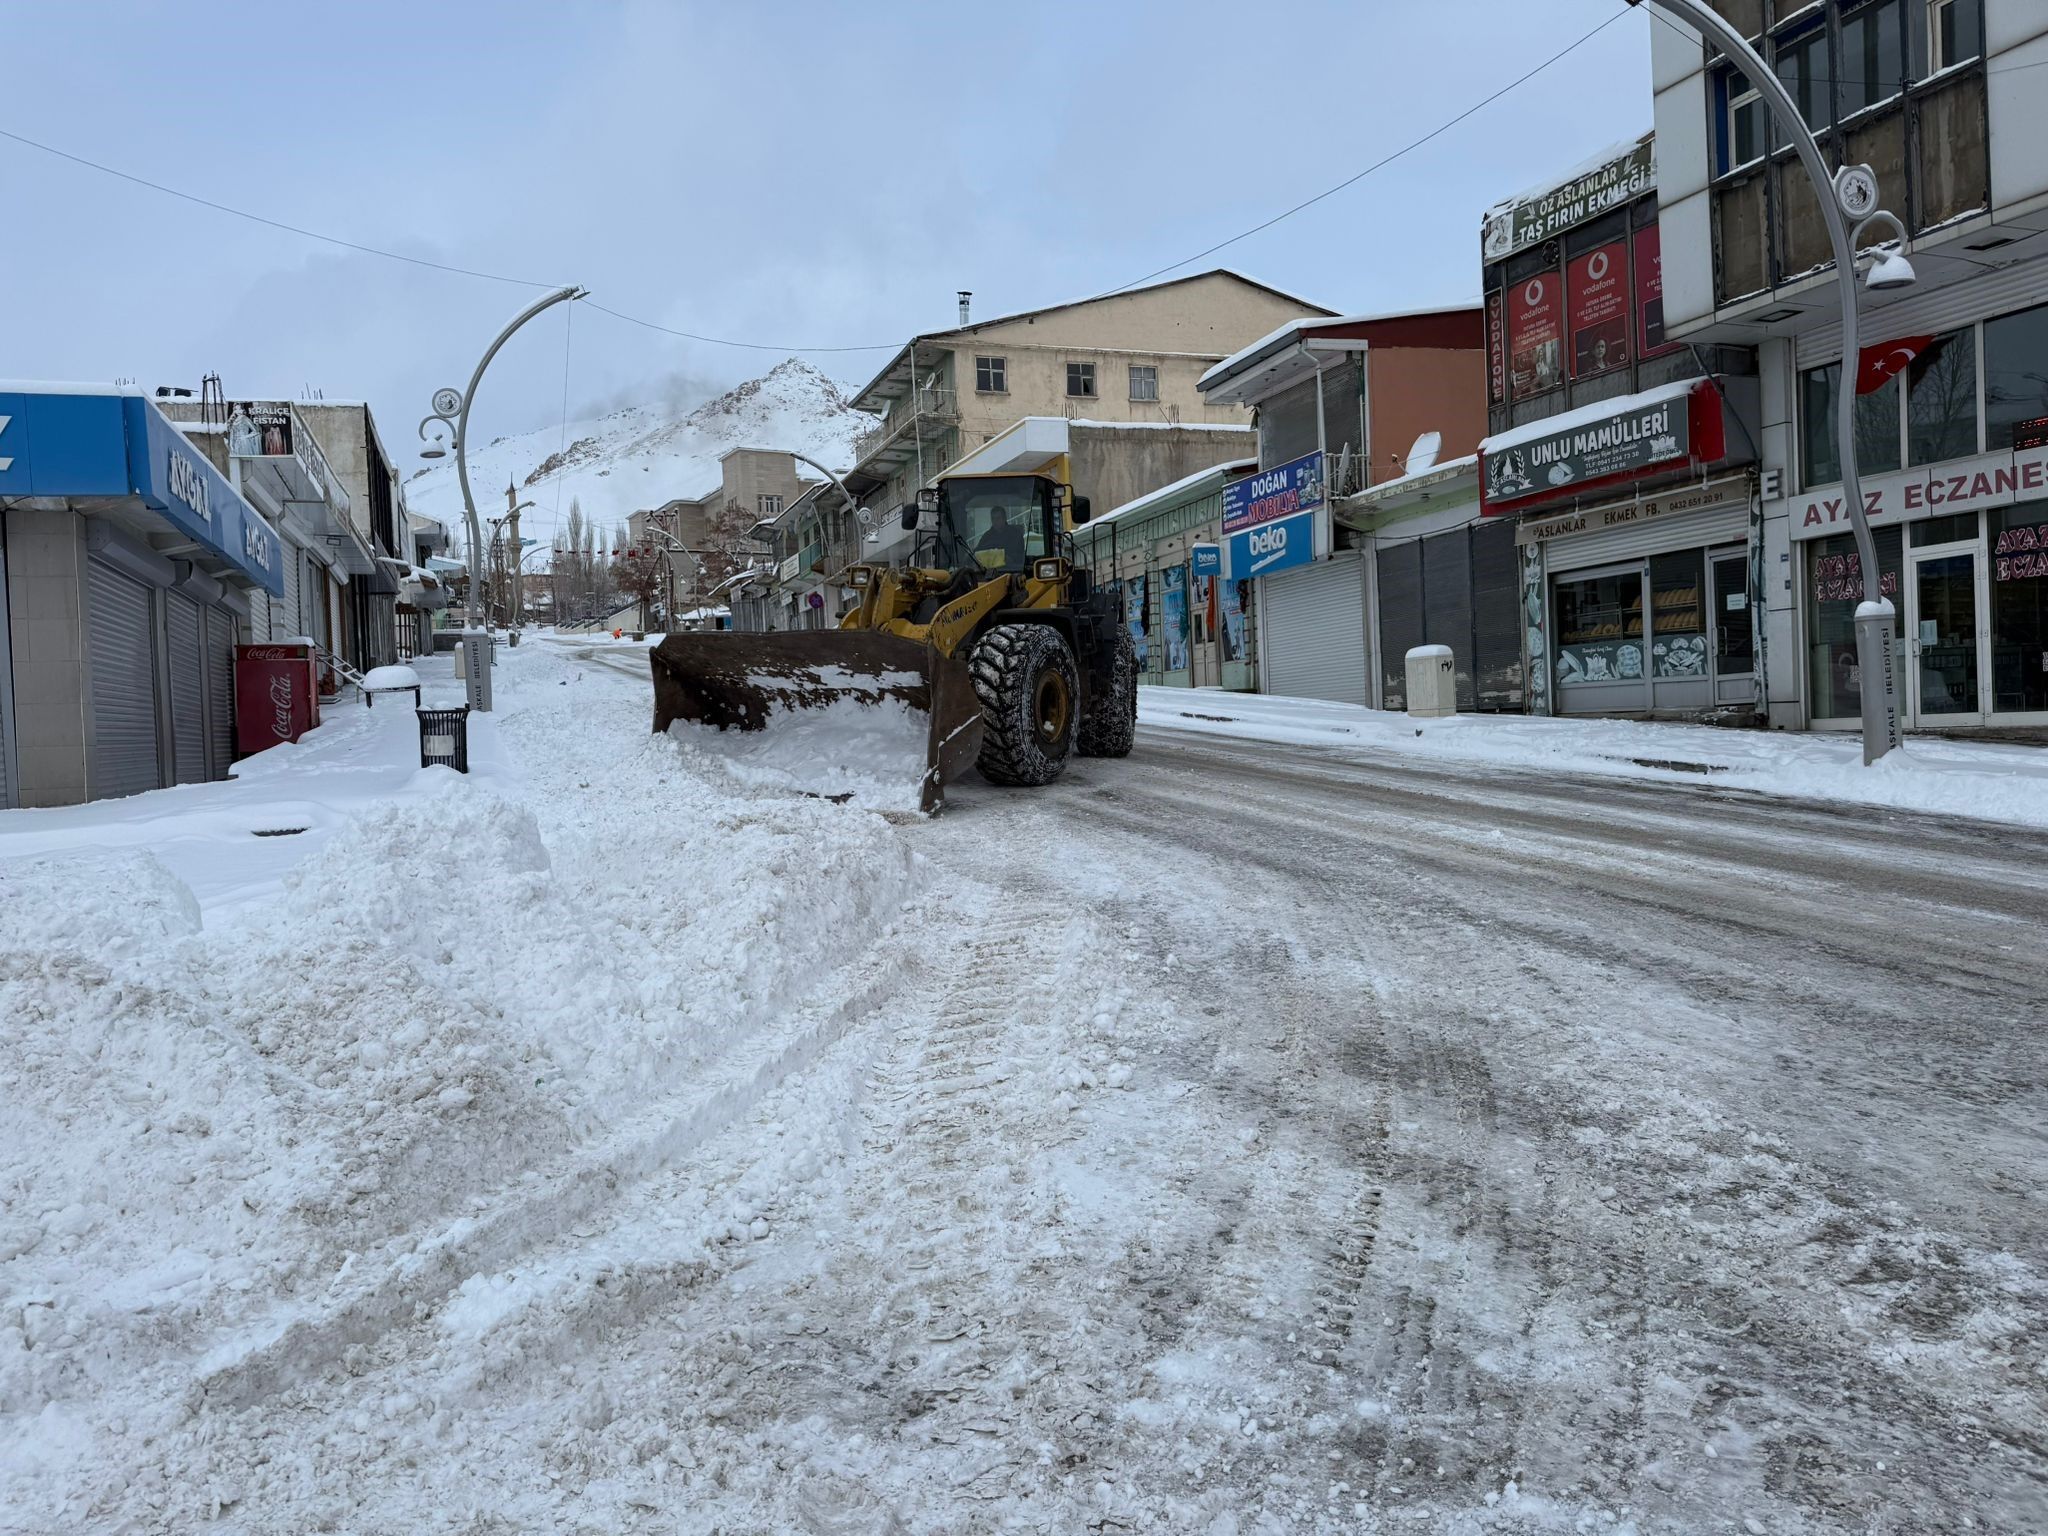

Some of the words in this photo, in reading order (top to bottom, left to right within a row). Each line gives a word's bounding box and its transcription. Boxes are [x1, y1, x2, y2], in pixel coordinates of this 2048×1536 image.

[1519, 219, 1543, 243] TAŞ
[1547, 202, 1584, 231] FIRIN
[1588, 165, 1645, 212] EKMEĞİ
[1583, 278, 1615, 296] vodafone
[1520, 304, 1550, 321] vodafone
[1531, 438, 1571, 466] UNLU
[1574, 403, 1668, 456] MAMÜLLERİ
[1251, 470, 1287, 499] DOĞAN
[1803, 491, 1882, 527] AYZ
[1904, 461, 2048, 509] ECZANE
[1605, 507, 1638, 525] EKMEK
[1670, 501, 1687, 511] 0432
[1249, 526, 1287, 556] beko
[1813, 553, 1859, 579] AYAZ
